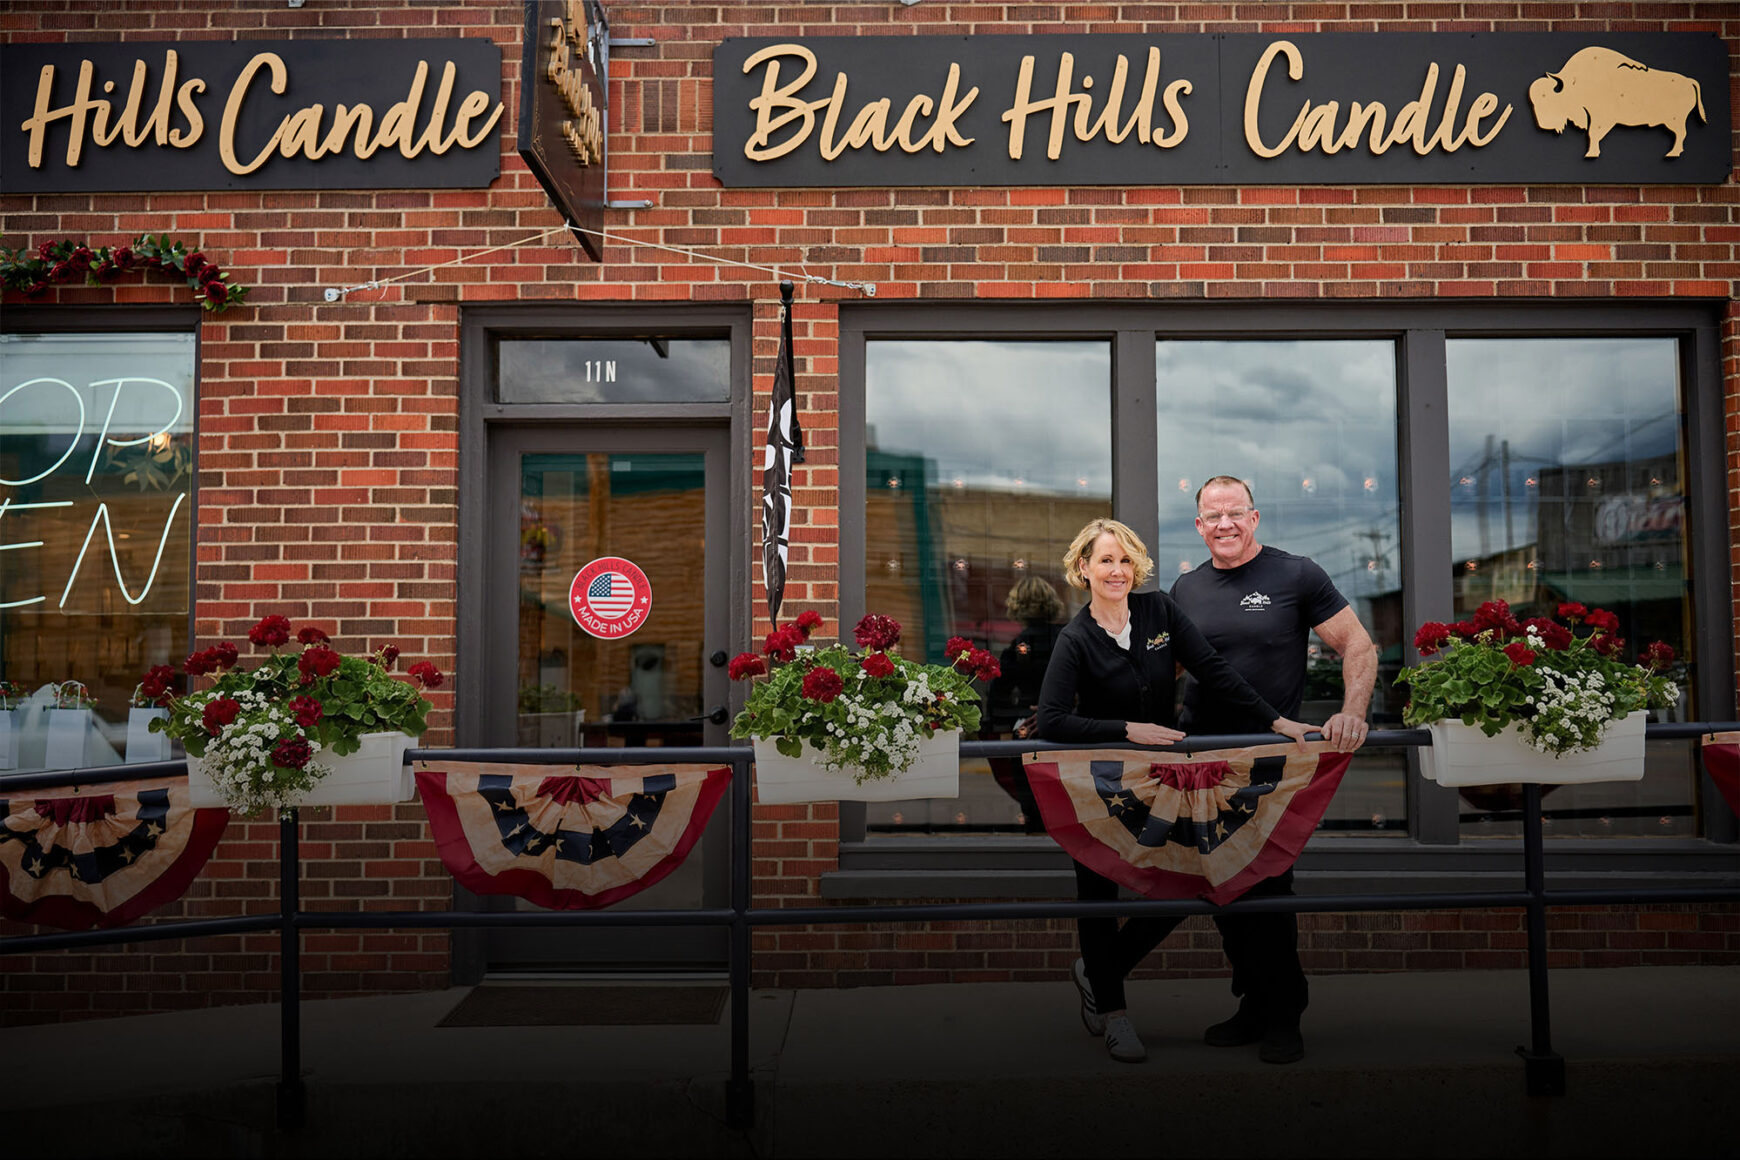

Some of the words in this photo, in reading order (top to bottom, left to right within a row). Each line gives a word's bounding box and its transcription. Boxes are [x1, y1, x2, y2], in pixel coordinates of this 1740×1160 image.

[22, 49, 207, 168] Hills
[219, 52, 505, 175] Candle
[742, 43, 980, 162] Black
[1002, 46, 1193, 160] Hills
[1244, 40, 1513, 158] Candle
[585, 360, 616, 383] 11N
[578, 606, 608, 633] MADE
[610, 622, 622, 634] IN
[622, 608, 644, 629] USA
